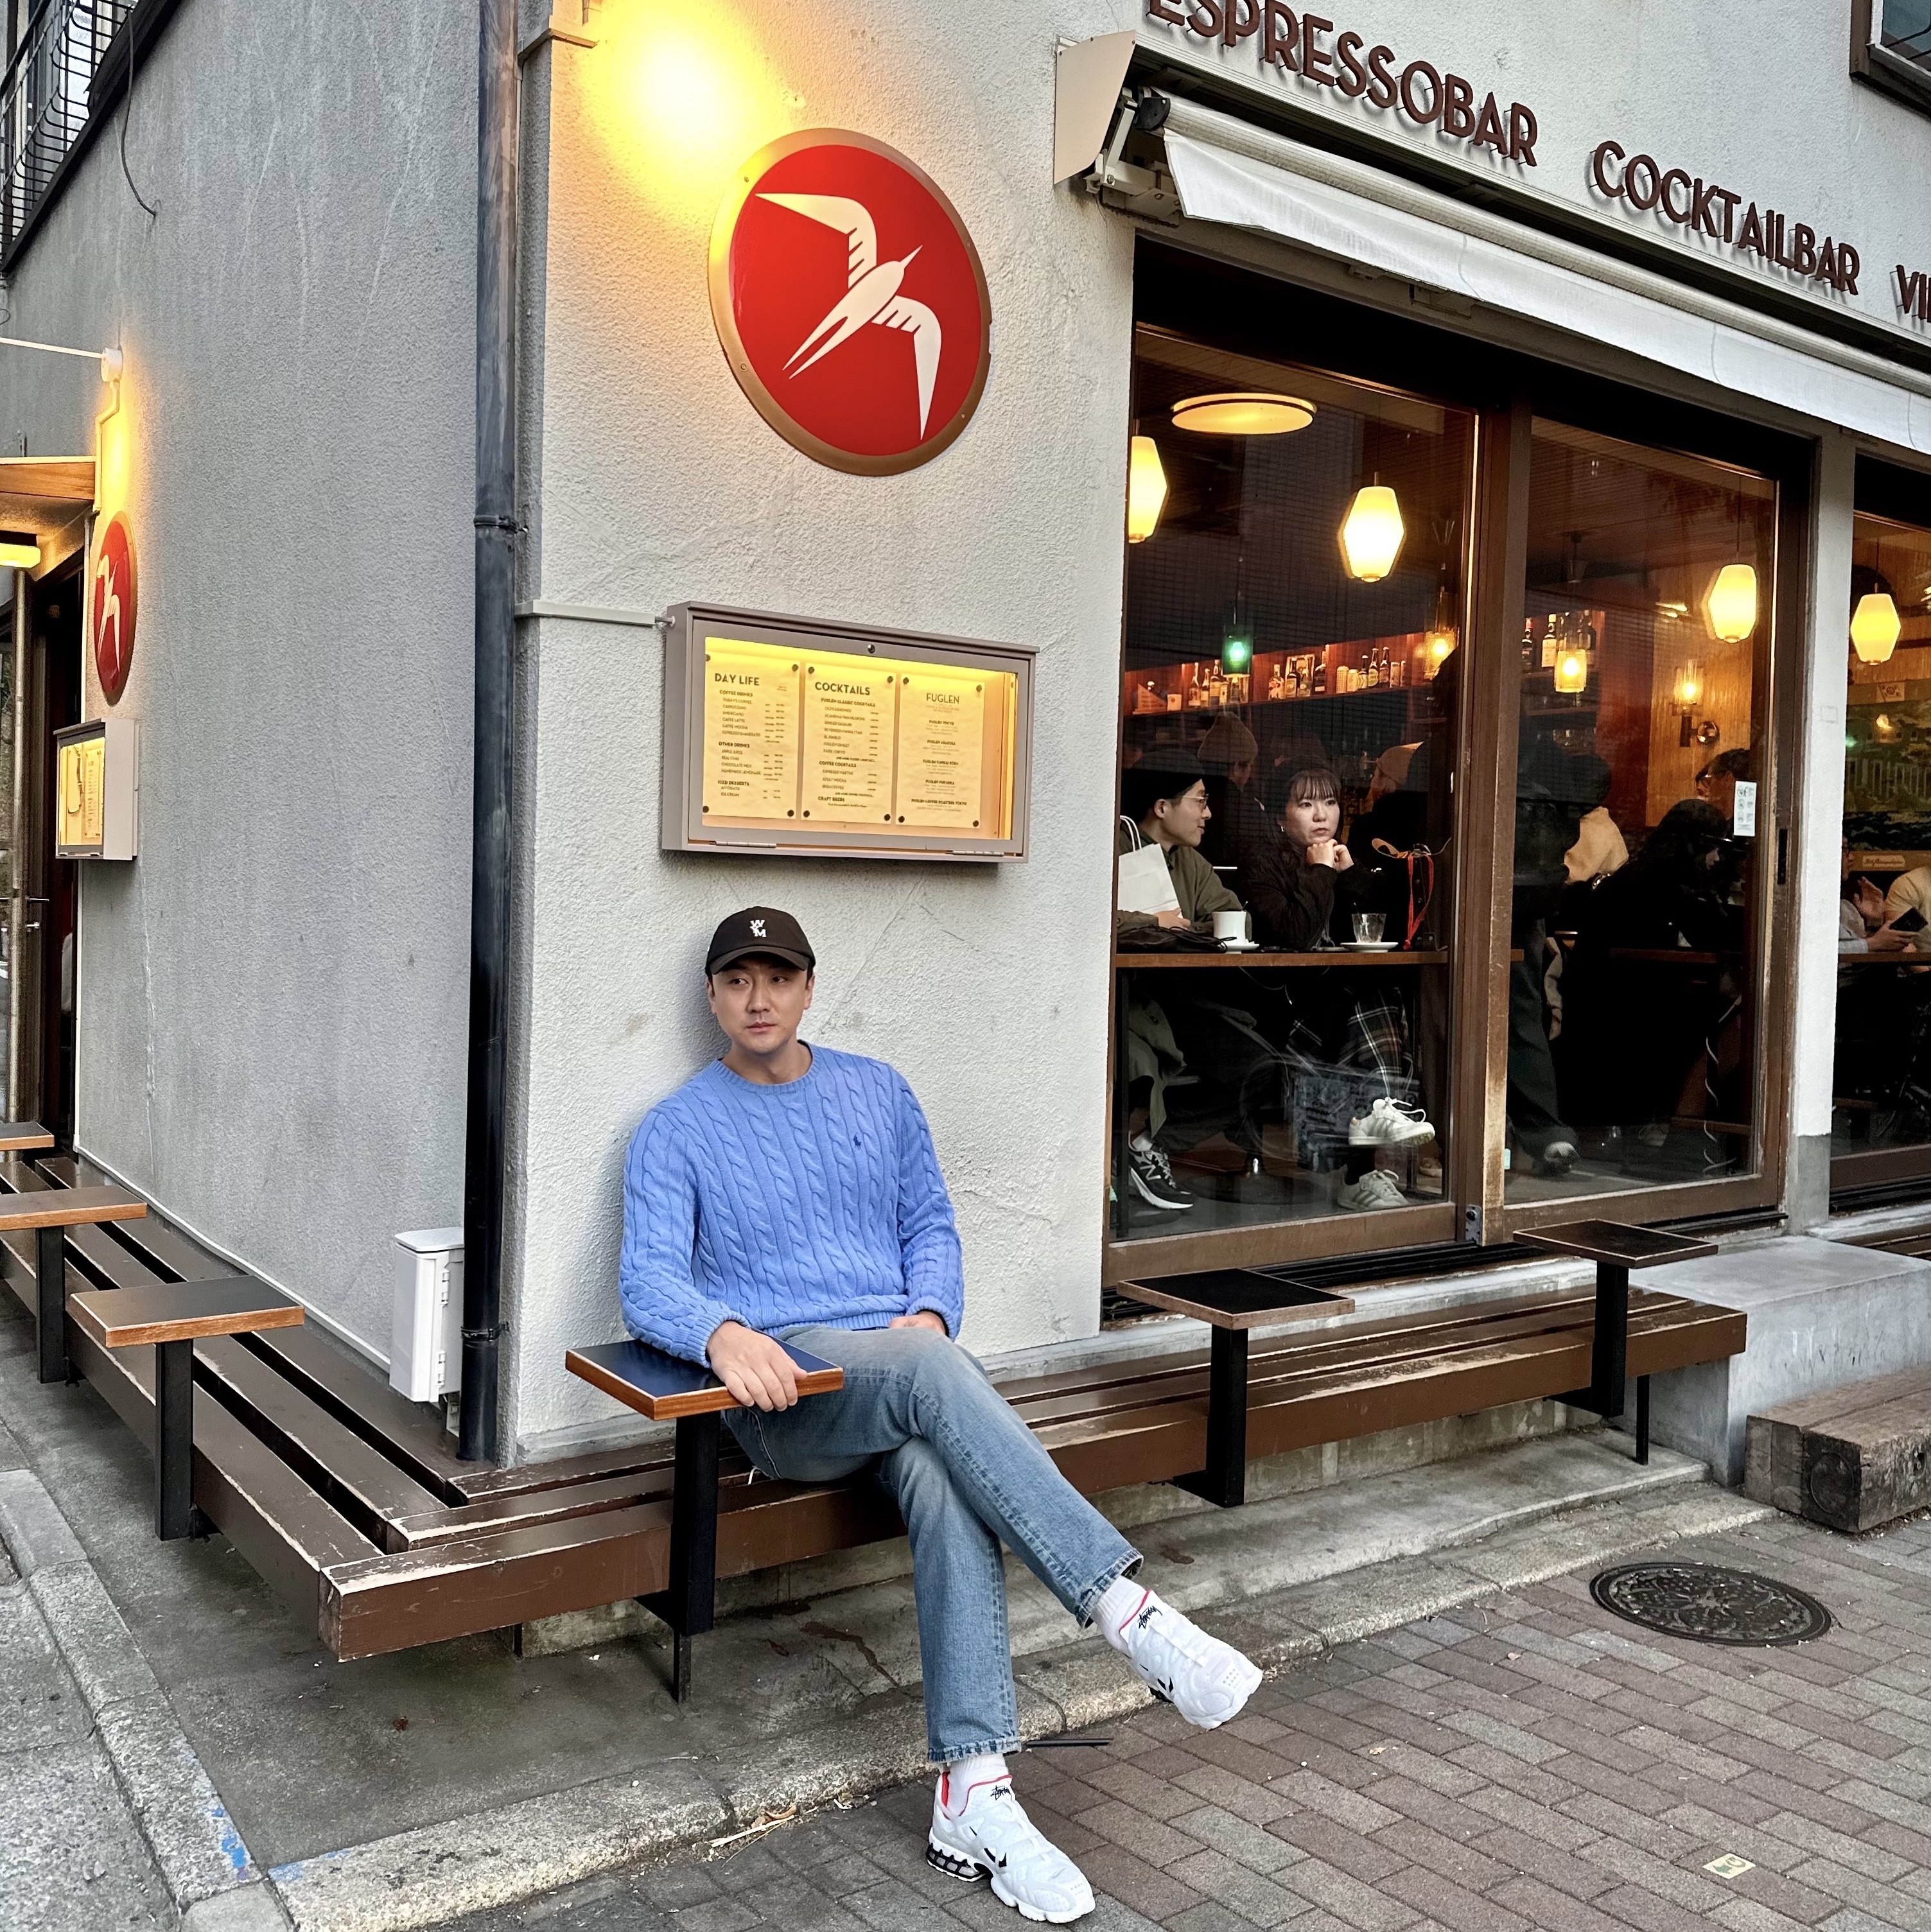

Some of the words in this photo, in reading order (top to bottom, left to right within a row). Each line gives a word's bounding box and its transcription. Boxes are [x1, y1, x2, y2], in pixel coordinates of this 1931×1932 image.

[1594, 140, 1860, 295] COCKTAILBAR
[1895, 264, 1931, 323] VI
[715, 673, 737, 683] DAY
[739, 675, 760, 686] LIFE
[815, 681, 871, 695] COCKTAILS
[926, 692, 959, 704] FUGLEN
